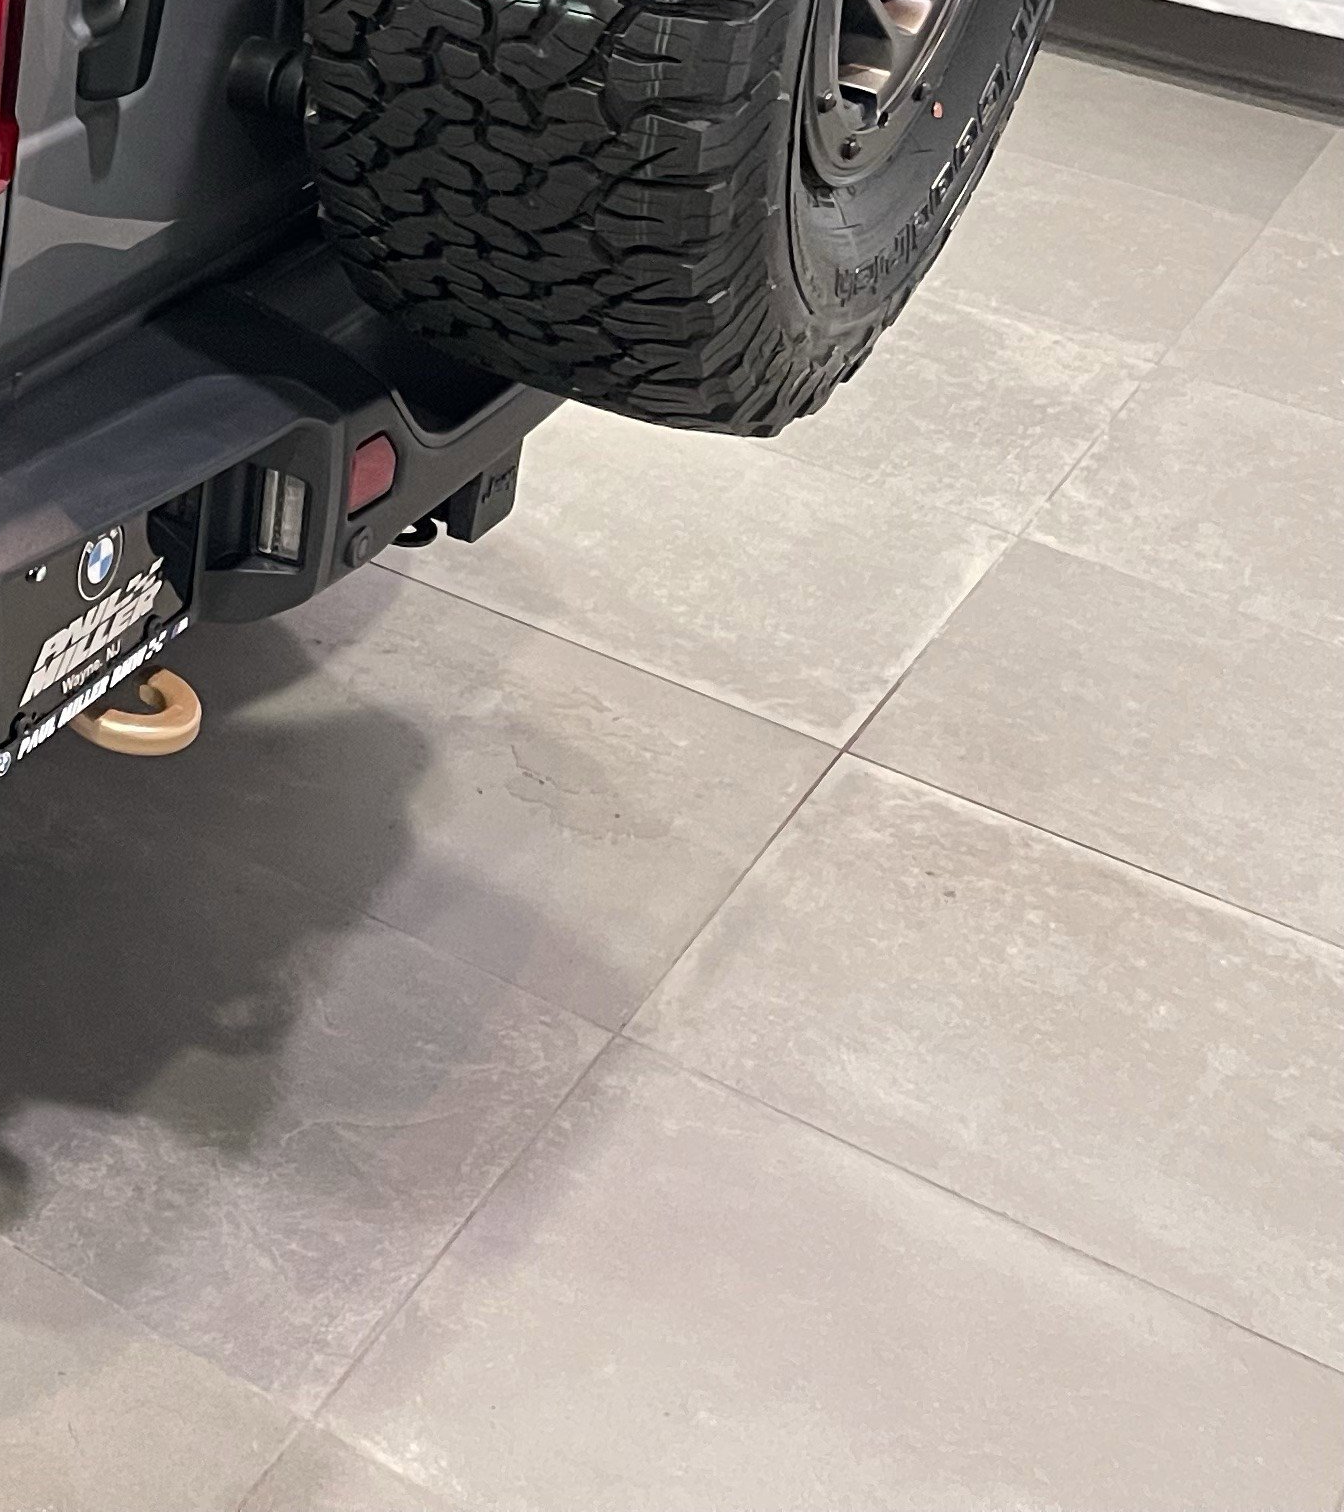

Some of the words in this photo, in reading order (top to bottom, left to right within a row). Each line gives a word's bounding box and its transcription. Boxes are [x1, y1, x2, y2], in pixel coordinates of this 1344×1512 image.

[18, 579, 163, 708] MILLER
[33, 587, 134, 674] PAUL
[16, 715, 57, 761] PAUL
[56, 674, 111, 729] MILLER
